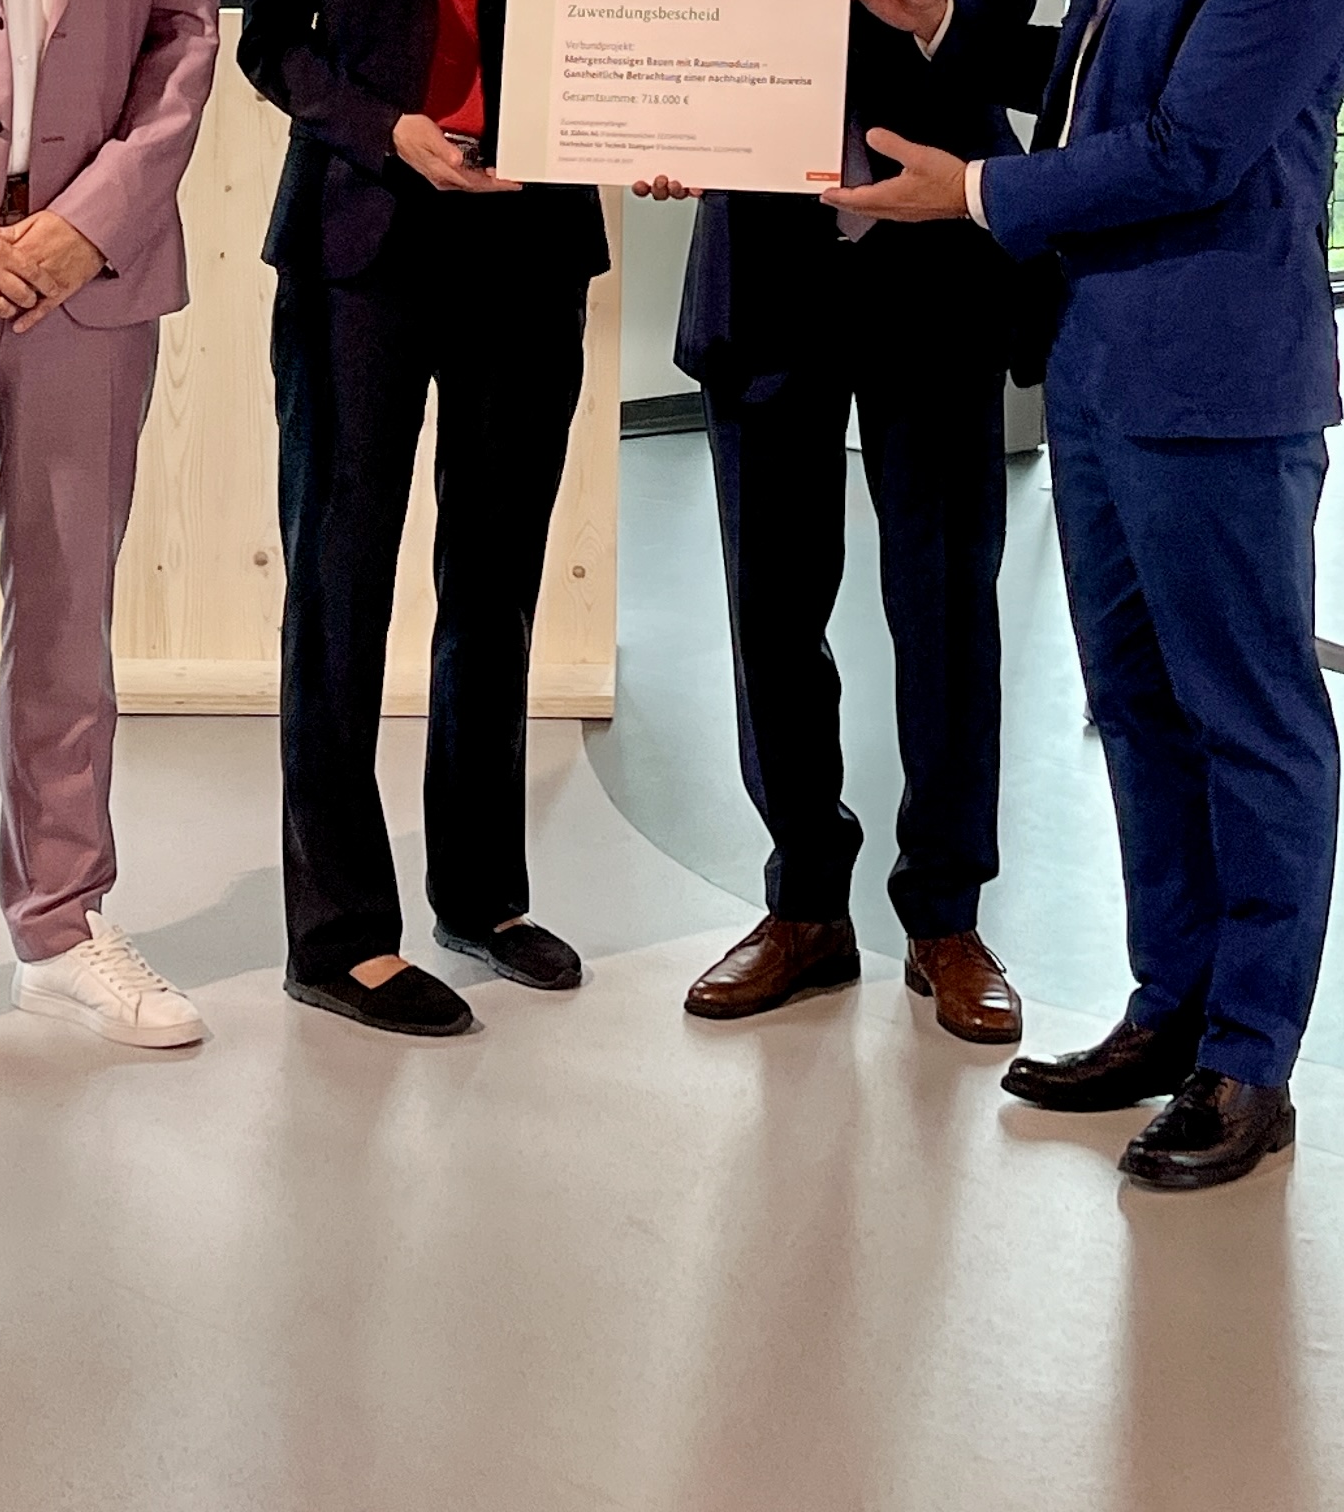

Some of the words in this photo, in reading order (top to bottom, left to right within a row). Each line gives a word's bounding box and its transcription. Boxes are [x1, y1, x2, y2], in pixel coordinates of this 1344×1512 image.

[566, 3, 721, 24] Zuwendungsbescheid
[564, 54, 644, 67] Mehrgeschossiges
[646, 56, 674, 67] Bauen
